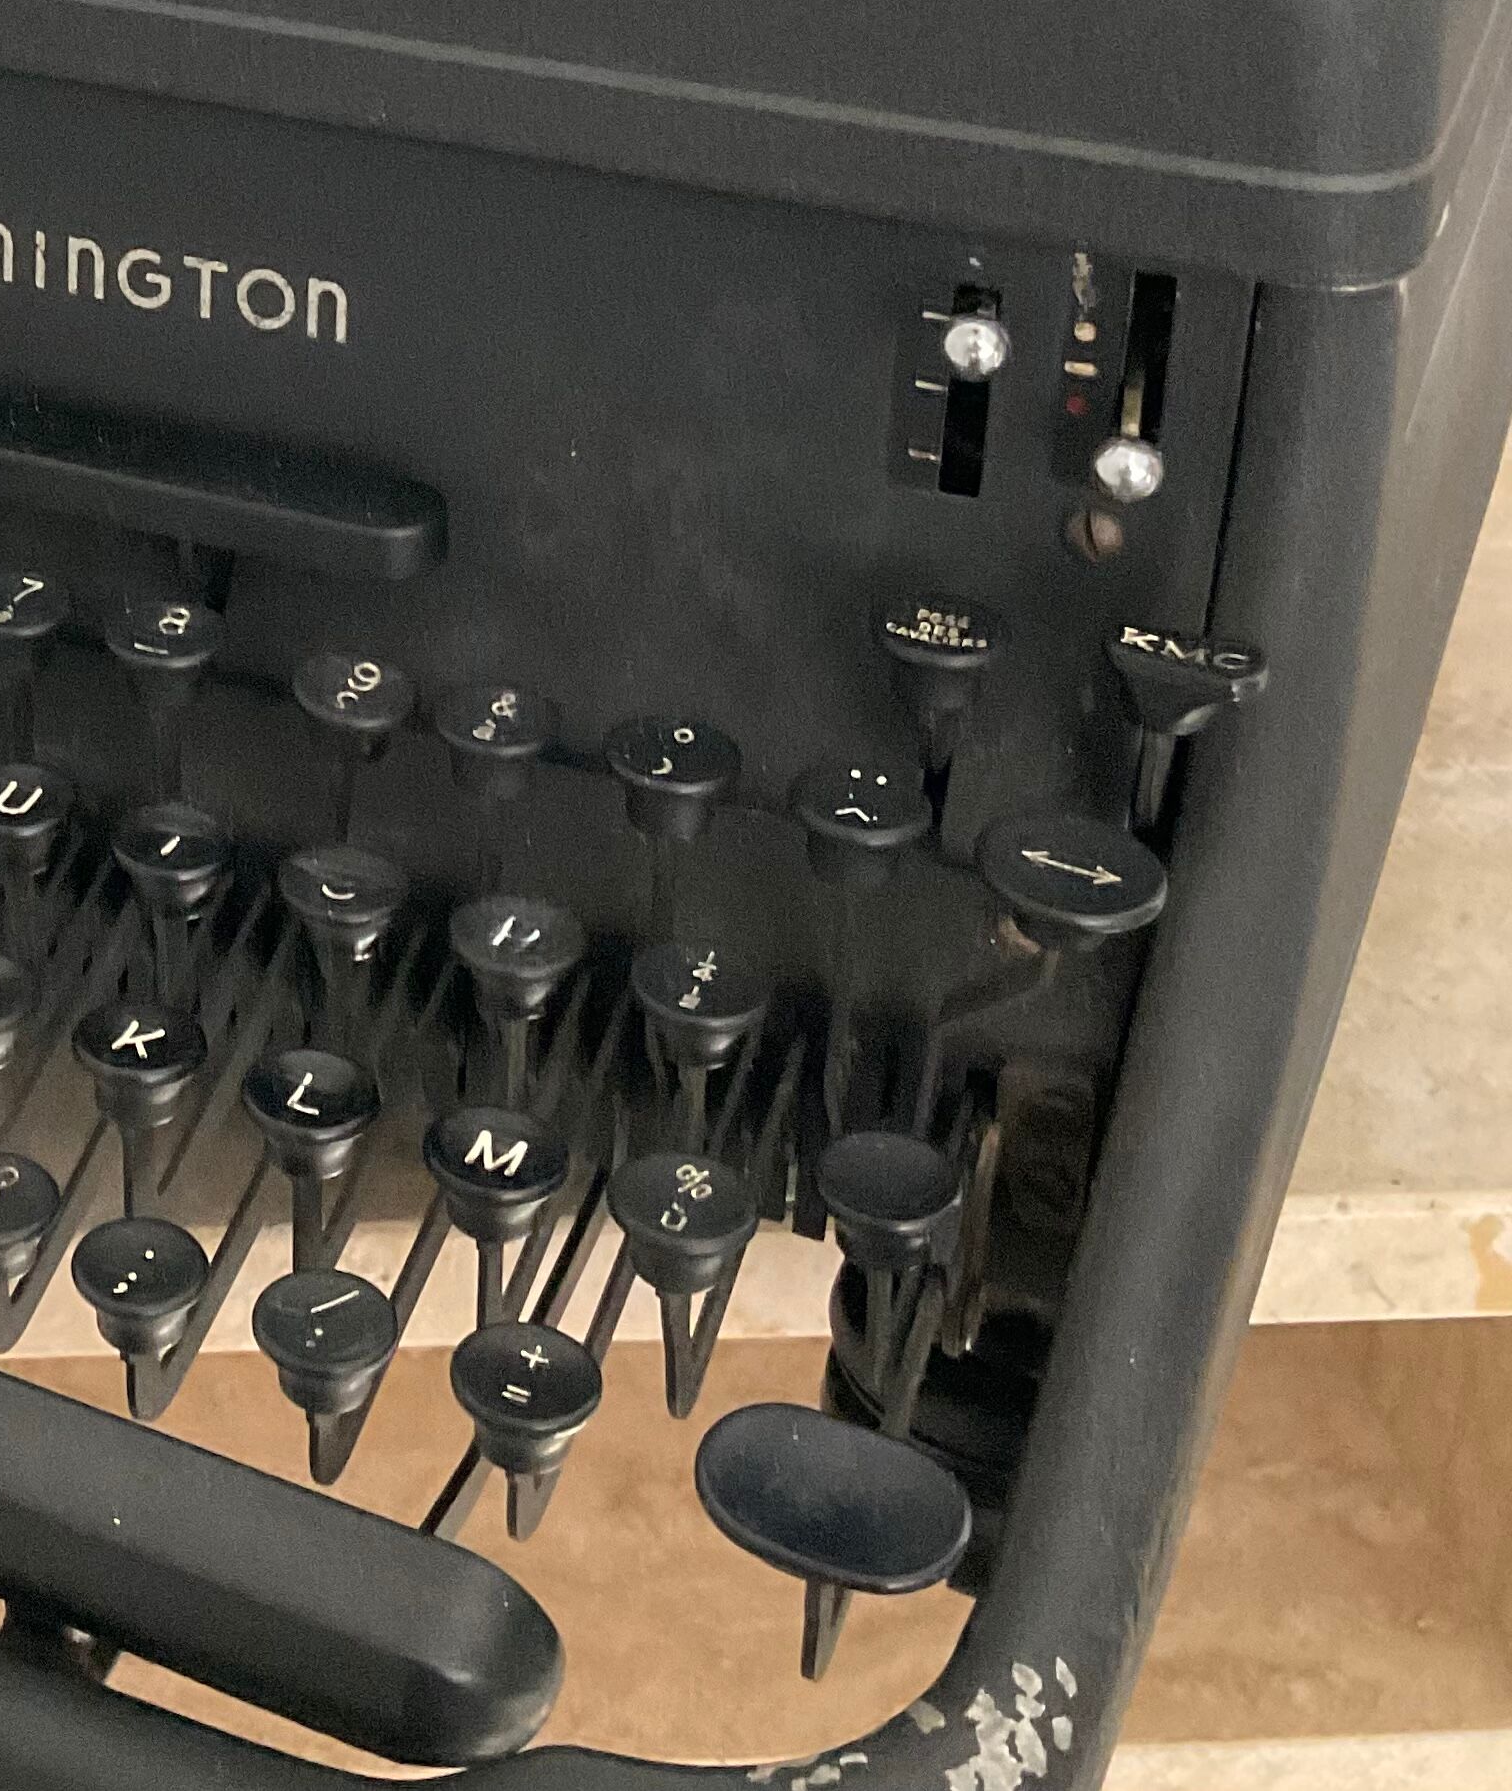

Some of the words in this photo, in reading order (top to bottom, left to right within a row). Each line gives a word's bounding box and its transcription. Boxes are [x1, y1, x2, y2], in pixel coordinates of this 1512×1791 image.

[13, 576, 44, 602] 7
[158, 607, 191, 635] 8
[347, 662, 381, 692] 9
[111, 1019, 166, 1059] K
[286, 1071, 320, 1116] L
[464, 1129, 529, 1176] M
[675, 1164, 713, 1200] %
[520, 1344, 549, 1369] +
[501, 1384, 532, 1404] =
